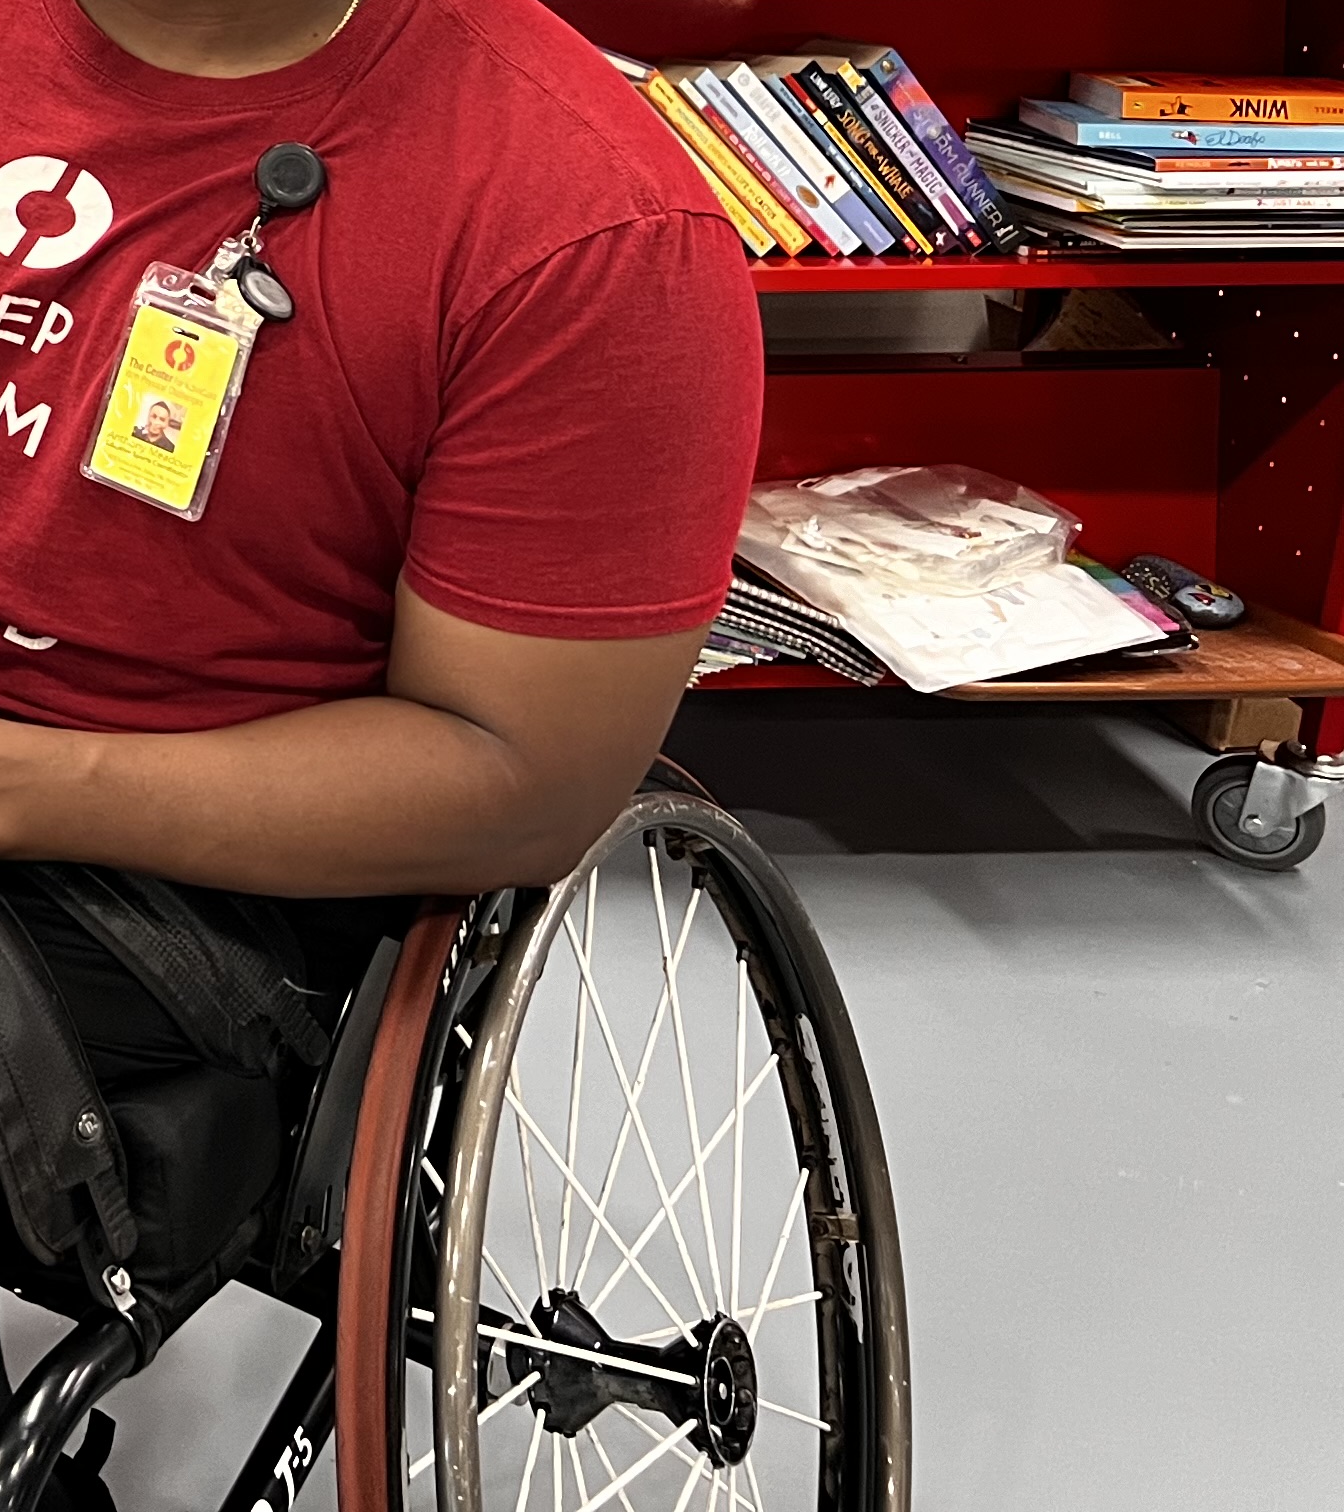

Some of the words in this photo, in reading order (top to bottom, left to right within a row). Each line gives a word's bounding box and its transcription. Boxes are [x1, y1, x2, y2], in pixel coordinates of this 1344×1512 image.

[1229, 98, 1289, 120] WINK
[738, 121, 769, 151] Roll
[834, 105, 871, 146] SONG
[875, 158, 914, 201] WHALE
[871, 108, 912, 153] SNICKER
[907, 154, 945, 196] MAGIC
[948, 161, 1005, 227] RUNNER
[128, 357, 146, 374] The
[145, 363, 174, 382] Center
